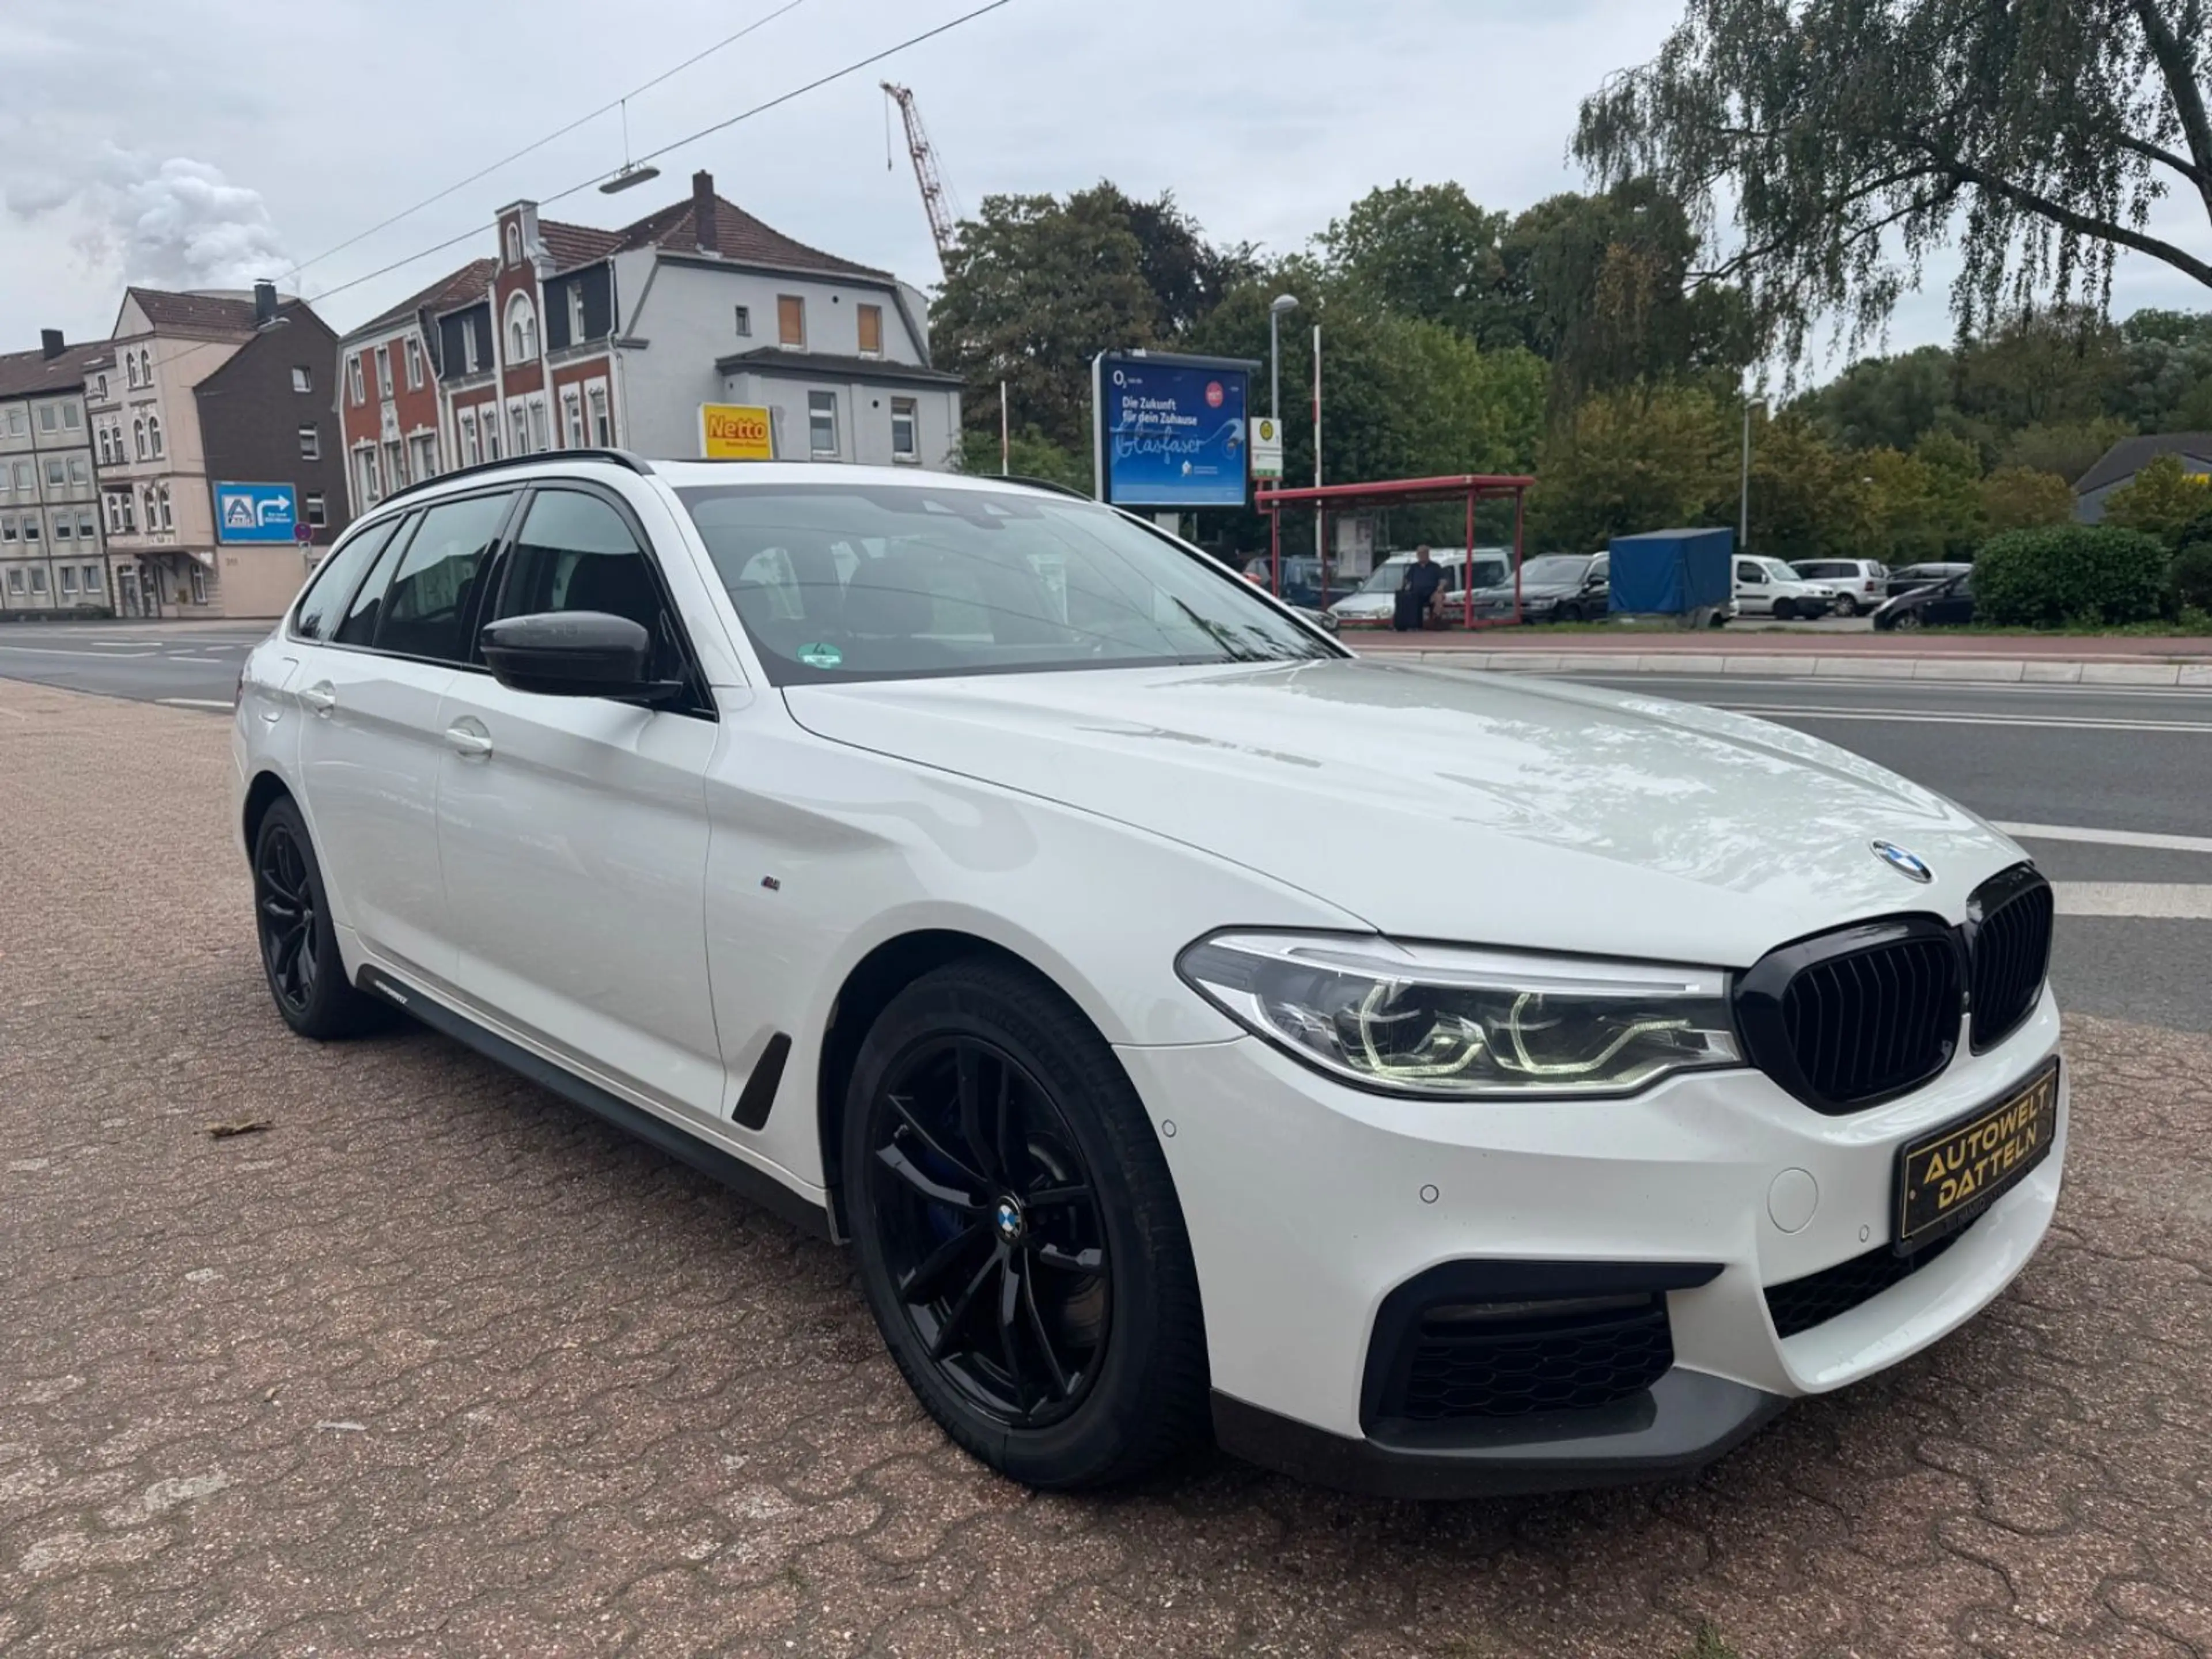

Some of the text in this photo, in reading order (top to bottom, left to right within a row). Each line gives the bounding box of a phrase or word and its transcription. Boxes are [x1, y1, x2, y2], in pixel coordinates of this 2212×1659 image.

[1122, 396, 1176, 411] Die Zukunft
[1122, 410, 1198, 426] für dein Zuhause
[708, 414, 766, 439] Netto
[1115, 423, 1207, 464] Glasfaser
[1923, 1082, 2048, 1184] AUTOWELT
[1938, 1122, 2037, 1209] DATTELN
